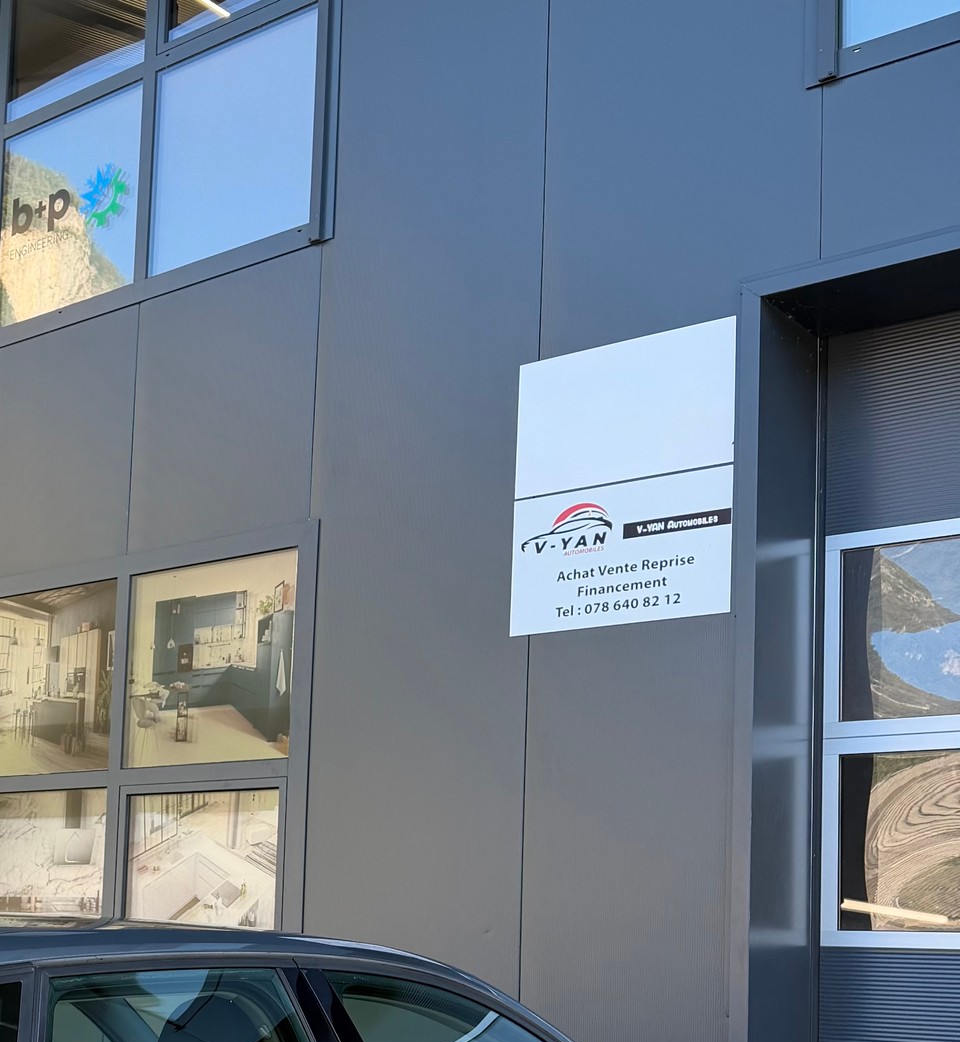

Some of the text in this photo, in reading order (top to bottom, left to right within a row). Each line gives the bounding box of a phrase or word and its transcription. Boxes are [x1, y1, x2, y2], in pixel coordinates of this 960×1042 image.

[11, 188, 71, 237] b+p
[9, 229, 69, 261] ENGINEERING
[636, 522, 665, 534] V-YAN
[534, 531, 608, 554] V-YAN
[563, 546, 605, 557] AUTOMOBILES
[556, 554, 695, 582] Achat Vente Reprise
[577, 576, 667, 597] Financement
[584, 601, 610, 615] 078
[613, 598, 639, 611] 640
[642, 595, 660, 608] 82
[665, 593, 681, 606] 12
